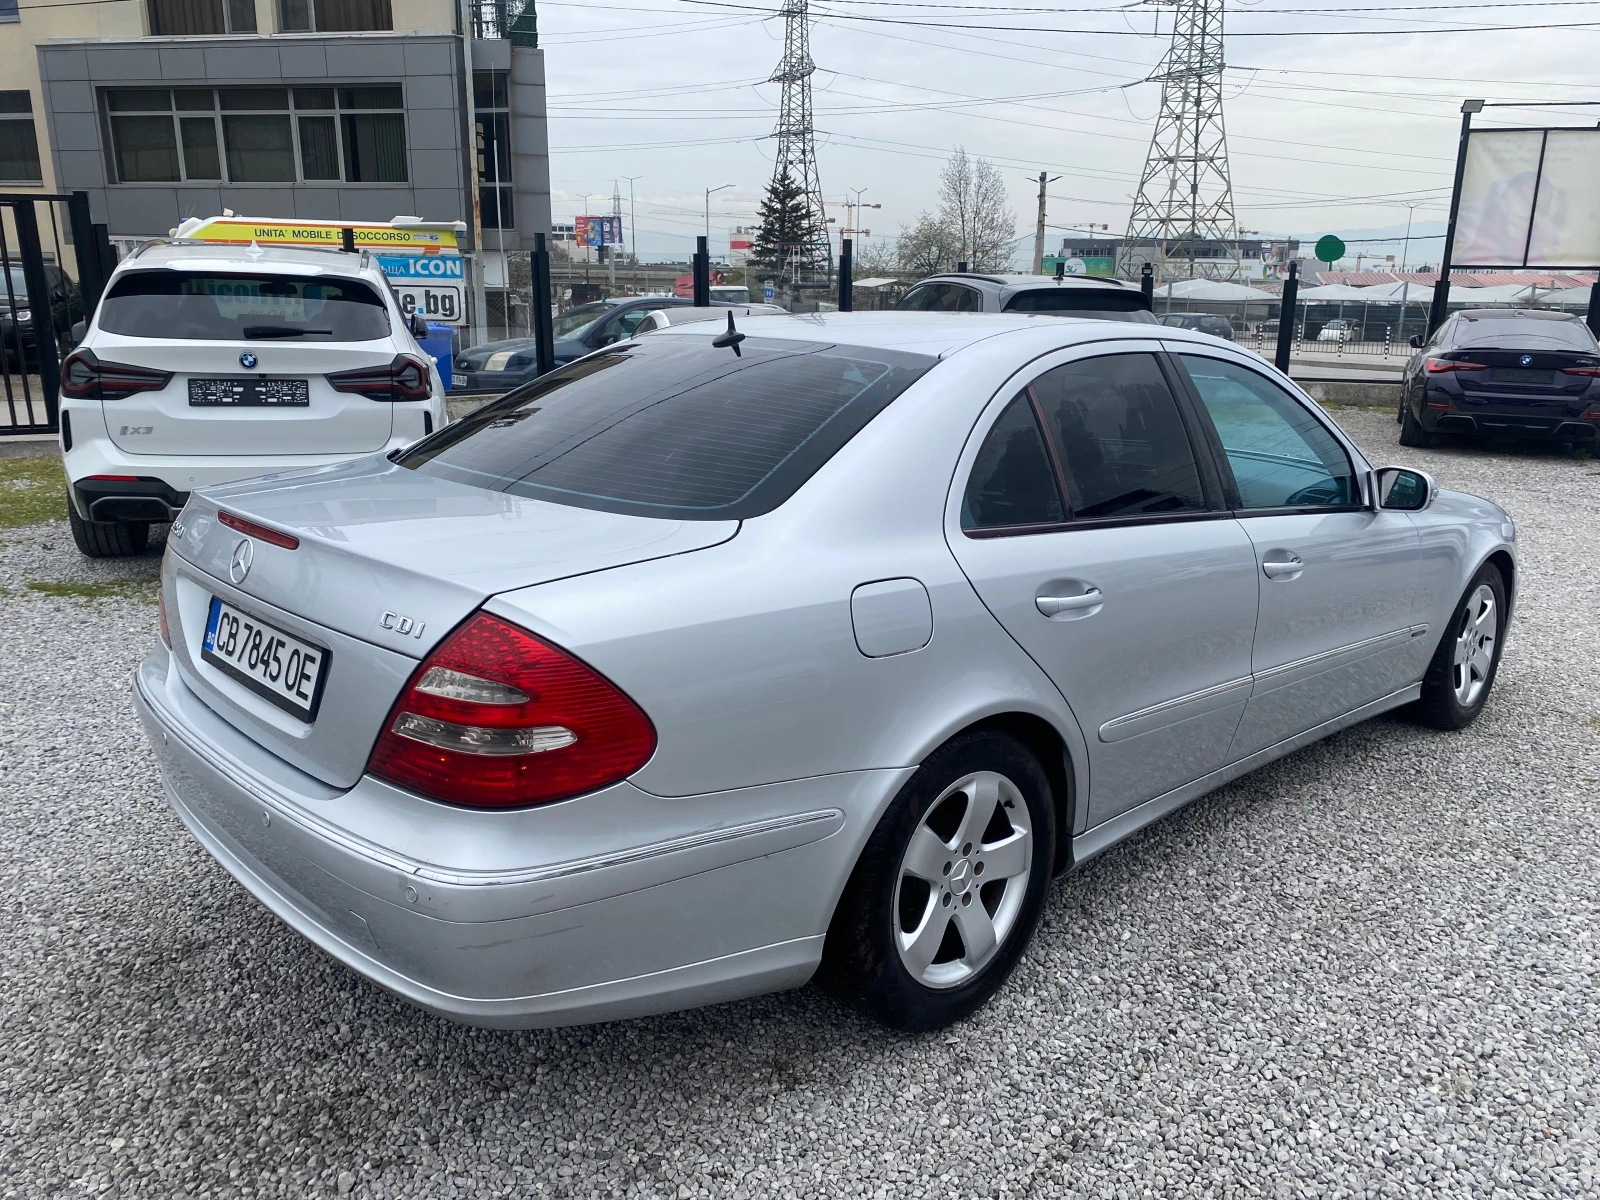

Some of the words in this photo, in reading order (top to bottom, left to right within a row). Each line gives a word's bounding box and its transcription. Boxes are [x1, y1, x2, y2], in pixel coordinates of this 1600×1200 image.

[292, 230, 332, 239] MOBILE
[353, 231, 411, 241] SOCCORSO
[408, 259, 460, 275] ICON
[393, 288, 455, 318] e.bg
[379, 610, 426, 640] CDI
